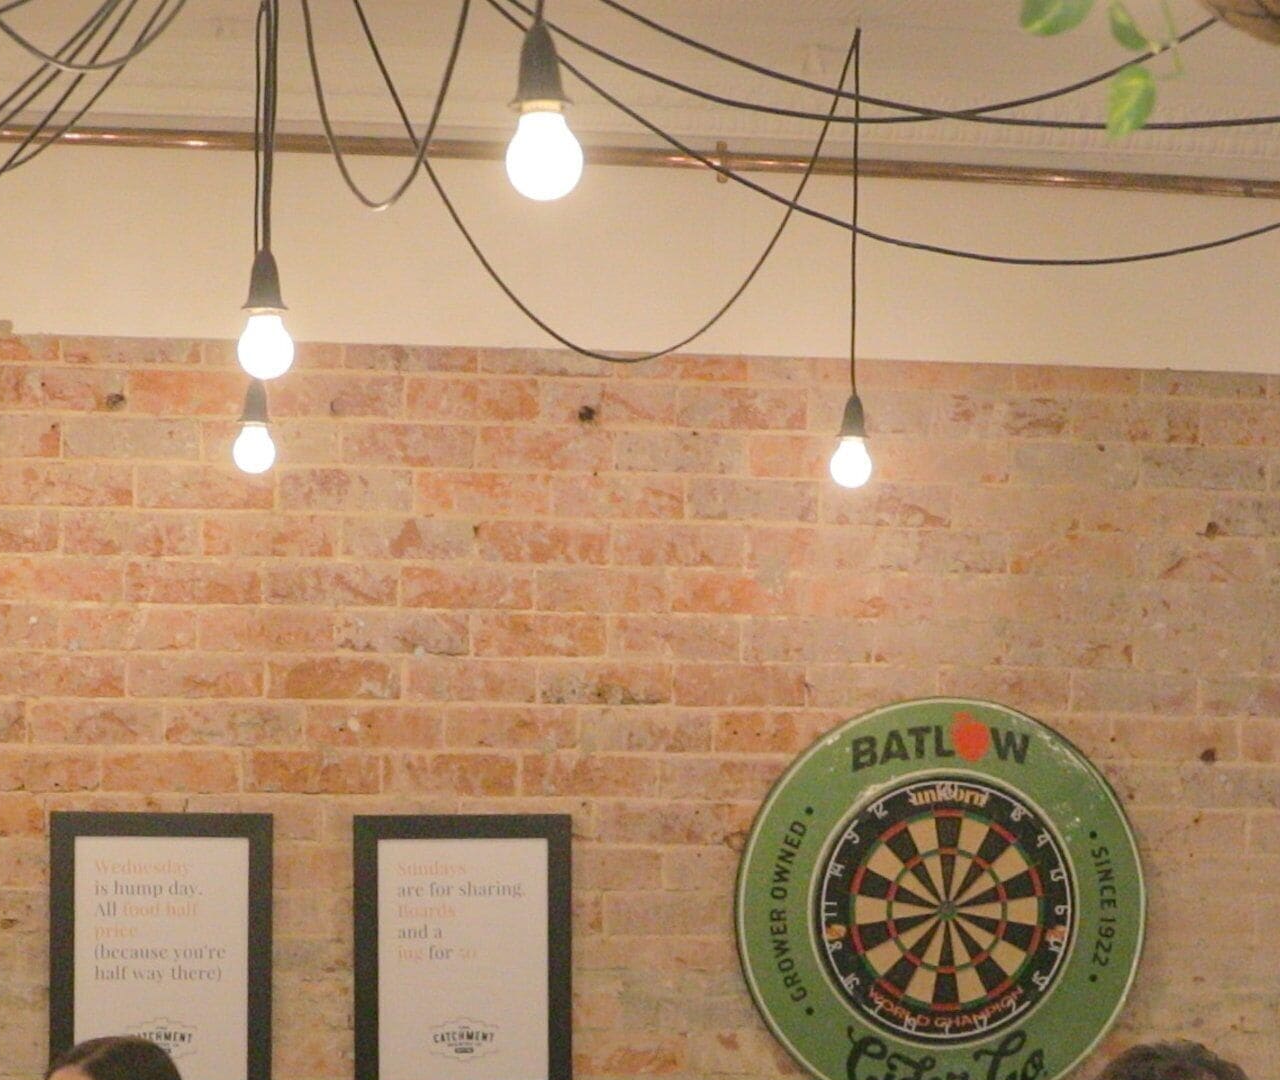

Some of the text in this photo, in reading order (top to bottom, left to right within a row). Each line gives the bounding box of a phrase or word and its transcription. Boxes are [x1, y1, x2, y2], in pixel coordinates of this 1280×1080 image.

[95, 859, 189, 877] Wednesday
[95, 880, 203, 898] is hump day.
[398, 883, 424, 898] are
[429, 881, 453, 897] for
[95, 901, 117, 917] All
[123, 902, 160, 917] food
[770, 821, 807, 1002] GROWER OWNED
[1091, 846, 1118, 967] SINCE 1922
[95, 922, 138, 940] price
[398, 923, 443, 939] and a
[94, 943, 227, 962] (because you're
[429, 944, 454, 960] for
[95, 964, 223, 984] half way there)
[432, 1030, 495, 1043] CATCHMENT
